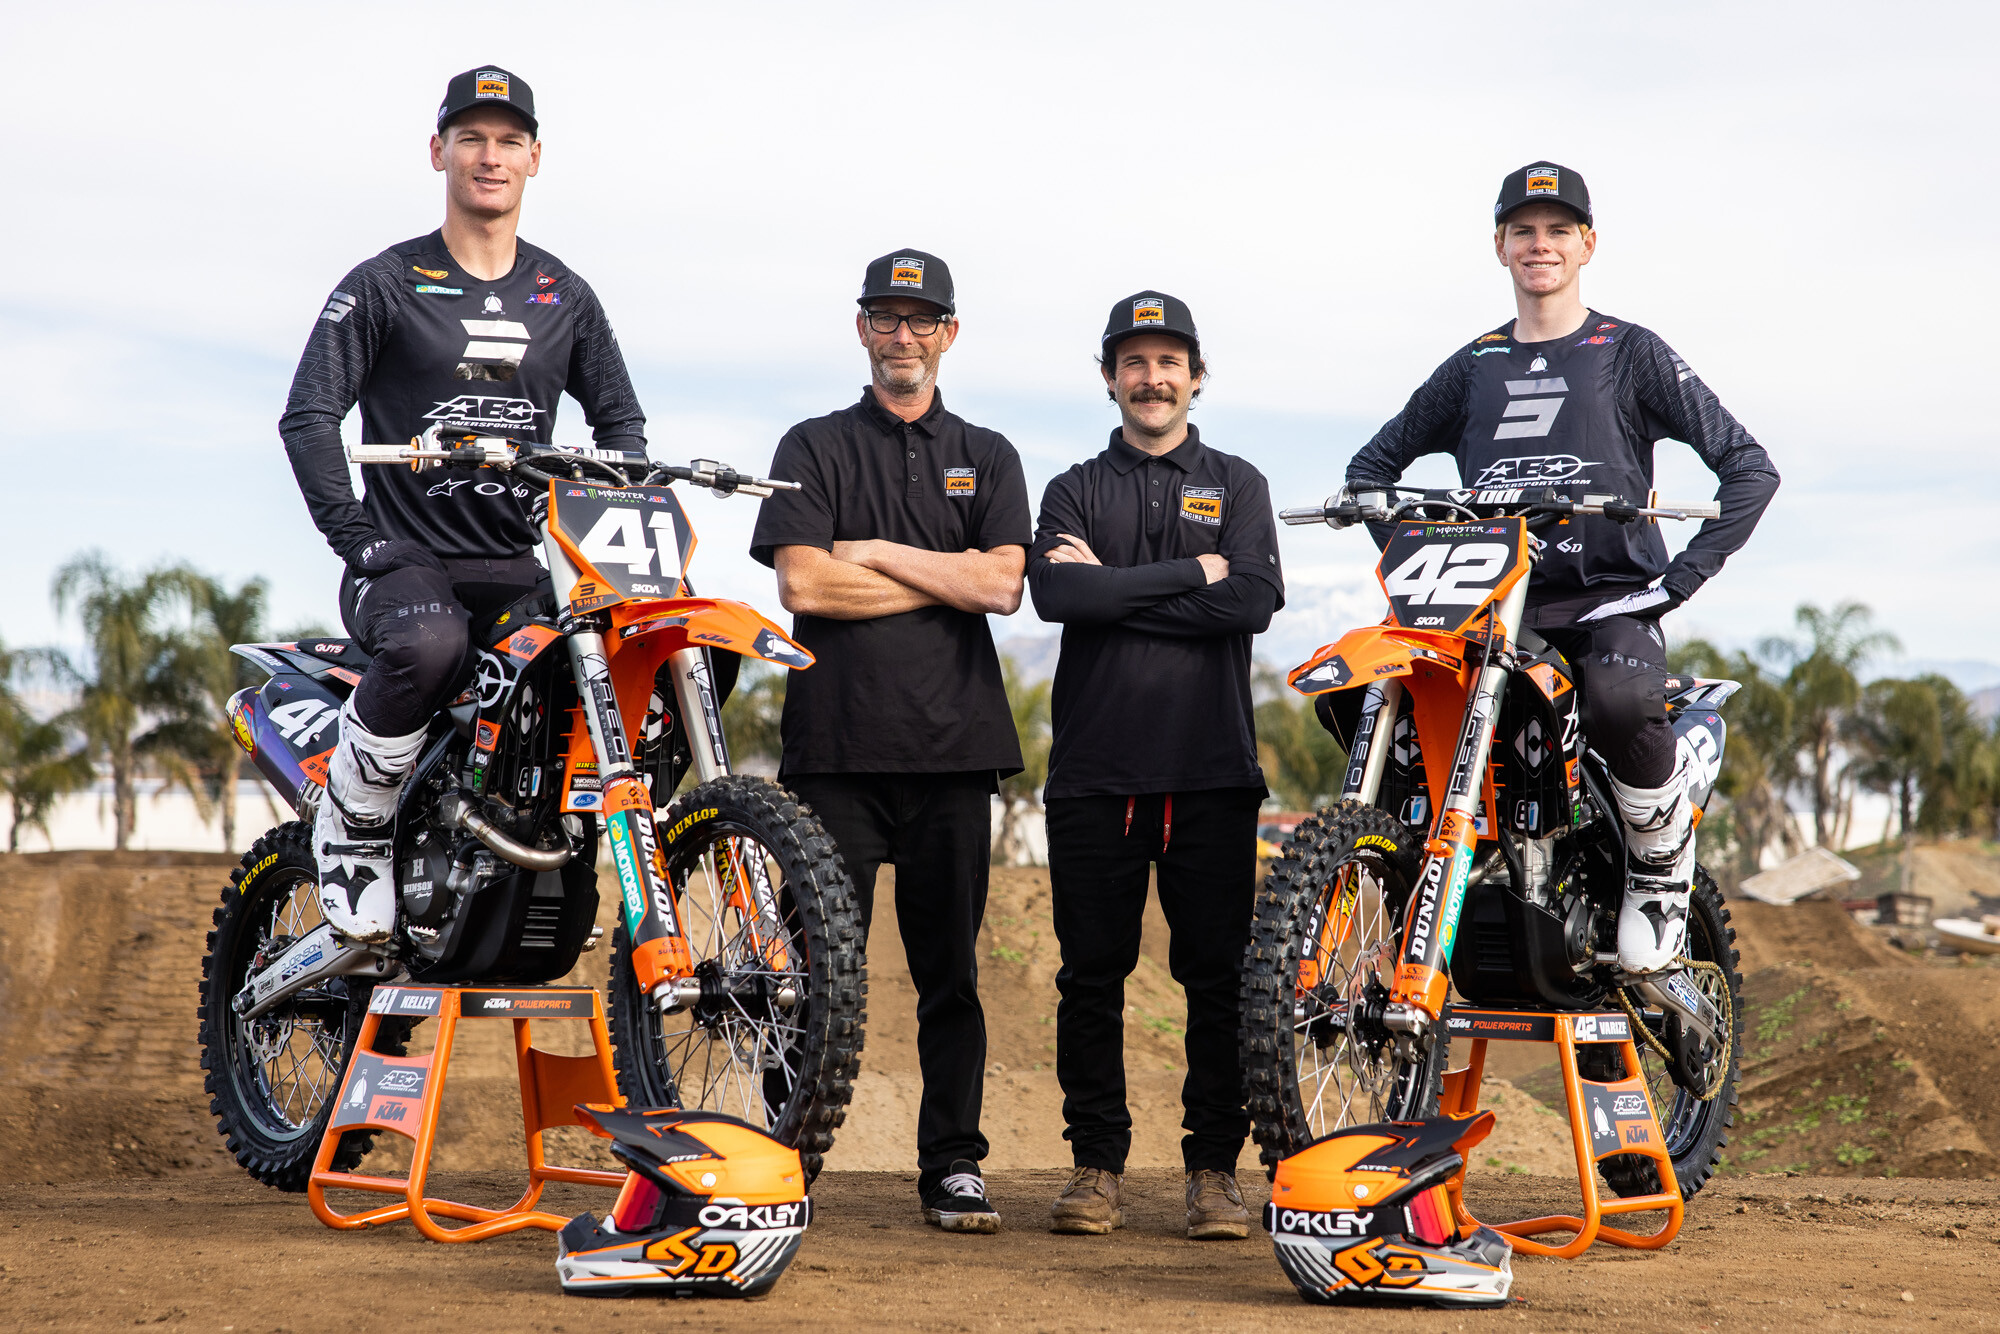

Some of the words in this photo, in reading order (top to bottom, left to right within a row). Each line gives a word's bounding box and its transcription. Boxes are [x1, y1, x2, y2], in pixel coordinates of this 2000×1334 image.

[482, 83, 504, 92] KTM
[1532, 179, 1553, 187] KTM
[897, 270, 918, 279] KTM
[525, 293, 562, 305] AMA
[1138, 310, 1159, 318] KTM
[421, 394, 547, 424] AEO
[1474, 454, 1605, 487] AEO
[1484, 479, 1592, 490] POWERSPORTS.COM
[566, 489, 588, 498] AMA
[597, 490, 646, 501] MONSTER
[648, 495, 668, 504] AMA
[1188, 501, 1216, 513] KTM
[1181, 510, 1203, 521] RACING
[1204, 516, 1219, 524] TEAM
[1403, 528, 1424, 537] AMA
[1435, 525, 1485, 535] MONSTER
[1485, 527, 1507, 535] AMA
[578, 507, 682, 579] 41
[1384, 542, 1510, 606] 42
[630, 583, 661, 595] SKDA
[575, 596, 605, 606] SHOT
[397, 602, 453, 618] SHOT
[1414, 616, 1445, 626] SKDA
[508, 635, 539, 656] KTM
[695, 633, 733, 645] KTM
[314, 643, 345, 655] GUTS
[1600, 653, 1651, 670] SHOT
[1373, 664, 1406, 676] KTM
[1545, 673, 1564, 695] KTM
[267, 698, 340, 749] 41
[592, 683, 615, 757] SUSPENSION
[599, 682, 626, 756] AEO
[1349, 715, 1375, 786] AEO
[666, 808, 719, 844] DUNLOP
[1353, 834, 1398, 852] DUNLOP
[238, 853, 279, 896] DUNLOP
[614, 839, 644, 919] MOTOREX
[403, 880, 433, 894] HINSON
[1445, 853, 1472, 927] MOTOREX
[369, 988, 399, 1014] 41
[400, 995, 437, 1010] KELLEY
[483, 998, 511, 1009] KTM
[514, 998, 572, 1010] POWERPARTS
[1447, 1017, 1472, 1029] KTM
[1473, 1020, 1533, 1032] POWERPARTS
[1575, 1016, 1598, 1041] 42
[1598, 1021, 1627, 1035] VARIZE
[377, 1070, 424, 1088] AEO
[1613, 1095, 1646, 1112] AEO
[374, 1101, 408, 1122] KTM
[1626, 1125, 1650, 1144] KTM
[698, 1203, 800, 1230] OAKLEY
[1281, 1209, 1374, 1236] OAKLEY
